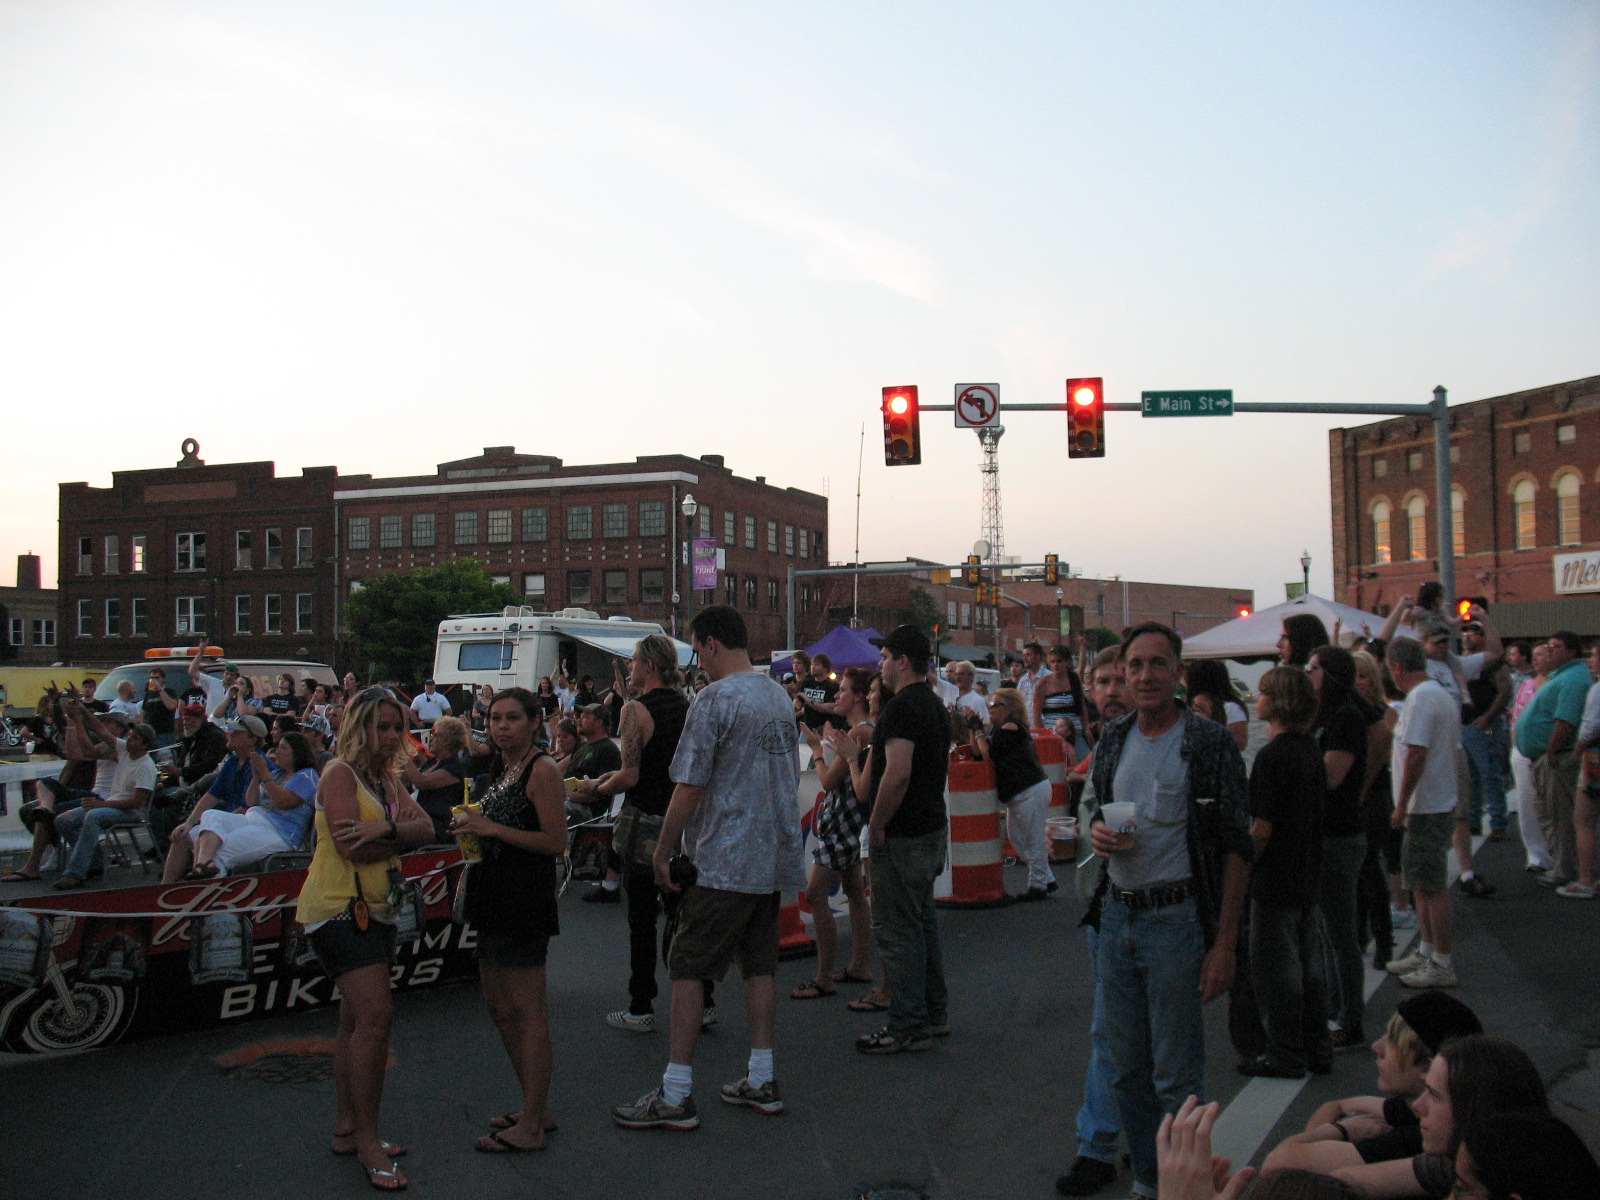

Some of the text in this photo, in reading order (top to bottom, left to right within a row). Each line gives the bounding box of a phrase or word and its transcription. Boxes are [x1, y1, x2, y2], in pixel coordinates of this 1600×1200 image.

[1144, 396, 1215, 411] E Main St
[220, 957, 444, 1019] BIKRS
